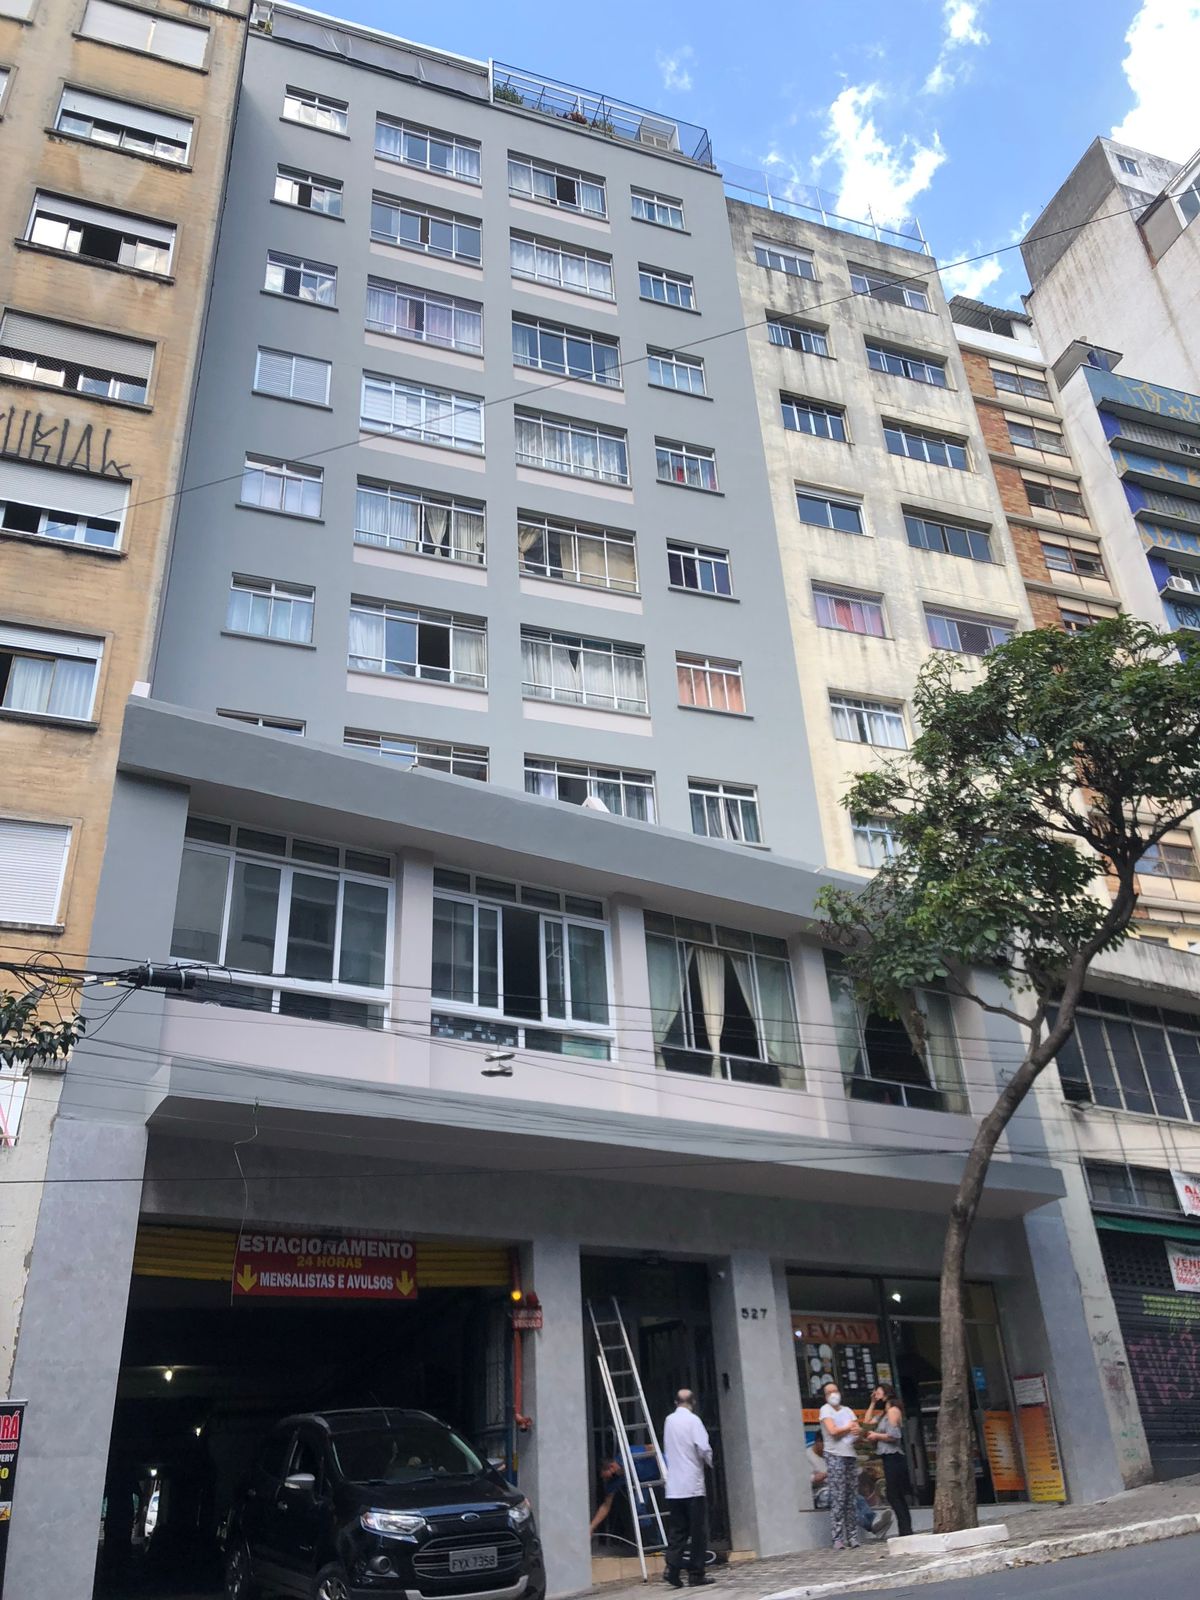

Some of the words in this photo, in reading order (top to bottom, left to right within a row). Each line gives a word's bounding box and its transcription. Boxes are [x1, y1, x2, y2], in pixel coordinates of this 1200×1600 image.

[239, 1235, 414, 1260] ESTACIONAMENTO
[296, 1255, 314, 1268] 24
[317, 1256, 364, 1270] HORAS
[259, 1271, 335, 1289] MENSALISTAS
[337, 1275, 346, 1288] E
[347, 1274, 394, 1291] AVULSOS
[740, 1307, 769, 1321] 527
[0, 1453, 14, 1462] ERY
